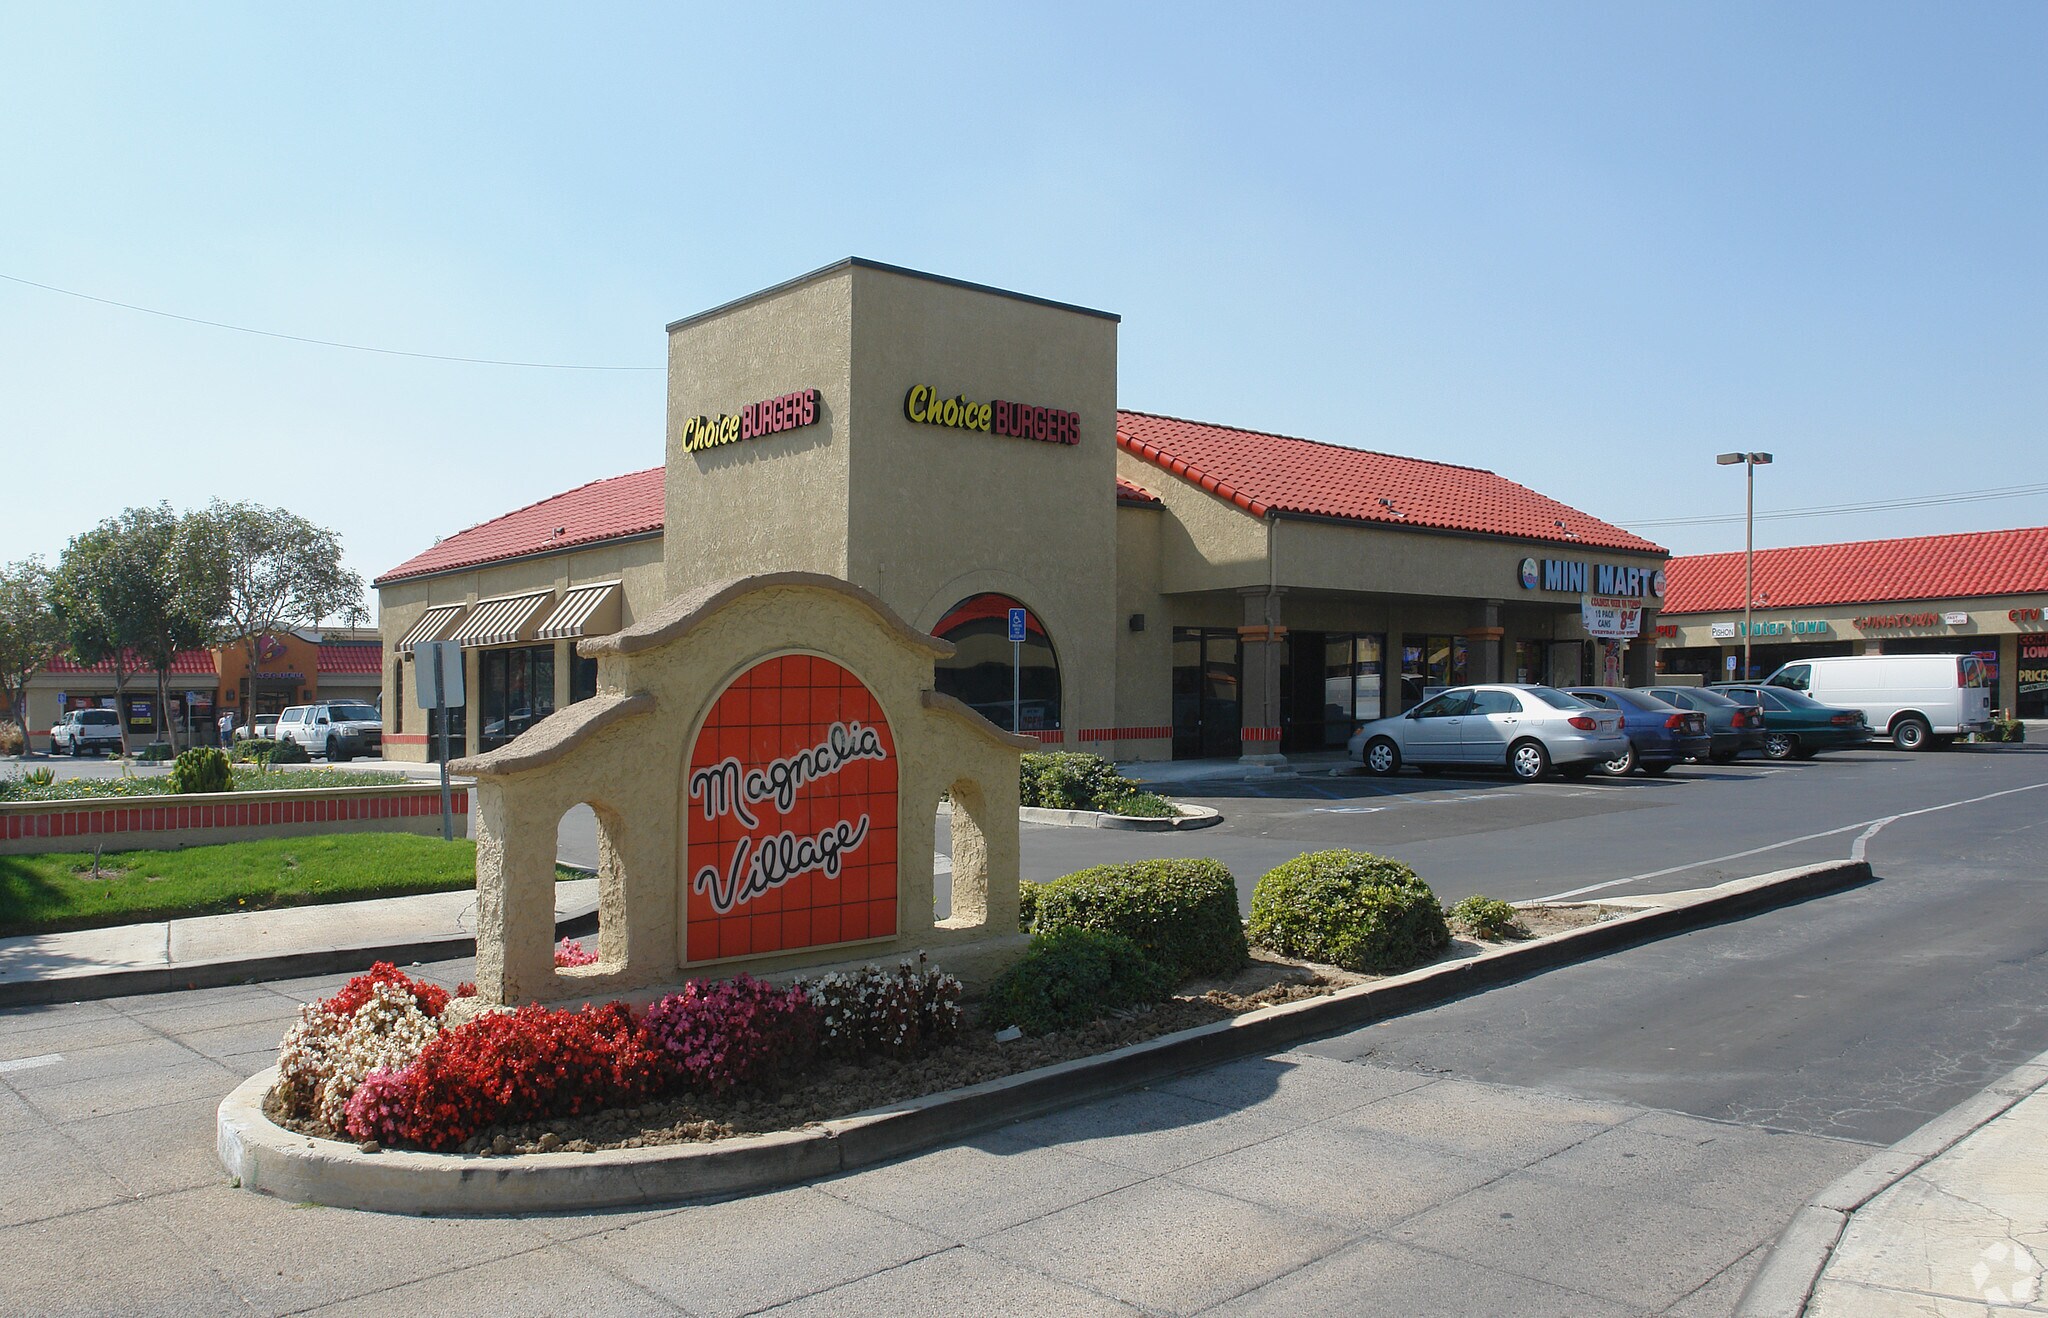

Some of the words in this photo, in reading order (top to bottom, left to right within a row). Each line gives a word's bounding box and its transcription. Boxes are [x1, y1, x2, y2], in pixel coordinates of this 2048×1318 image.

[682, 414, 740, 453] Choice
[742, 388, 818, 441] BURGERS
[906, 384, 992, 431] Choice
[995, 400, 1081, 445] BURGERS
[1543, 559, 1589, 593] MINI
[1598, 564, 1650, 597] MART
[1598, 619, 1611, 628] CANS
[1602, 610, 1614, 619] PACK
[1852, 612, 1939, 630] CHINATOWN
[2008, 607, 2040, 622] CTV
[1712, 627, 1734, 637] PISHON
[1739, 618, 1786, 637] Water
[1791, 618, 1828, 635] town
[256, 671, 278, 679] ACO
[690, 720, 886, 829] Magnolia
[694, 813, 870, 914] Village
